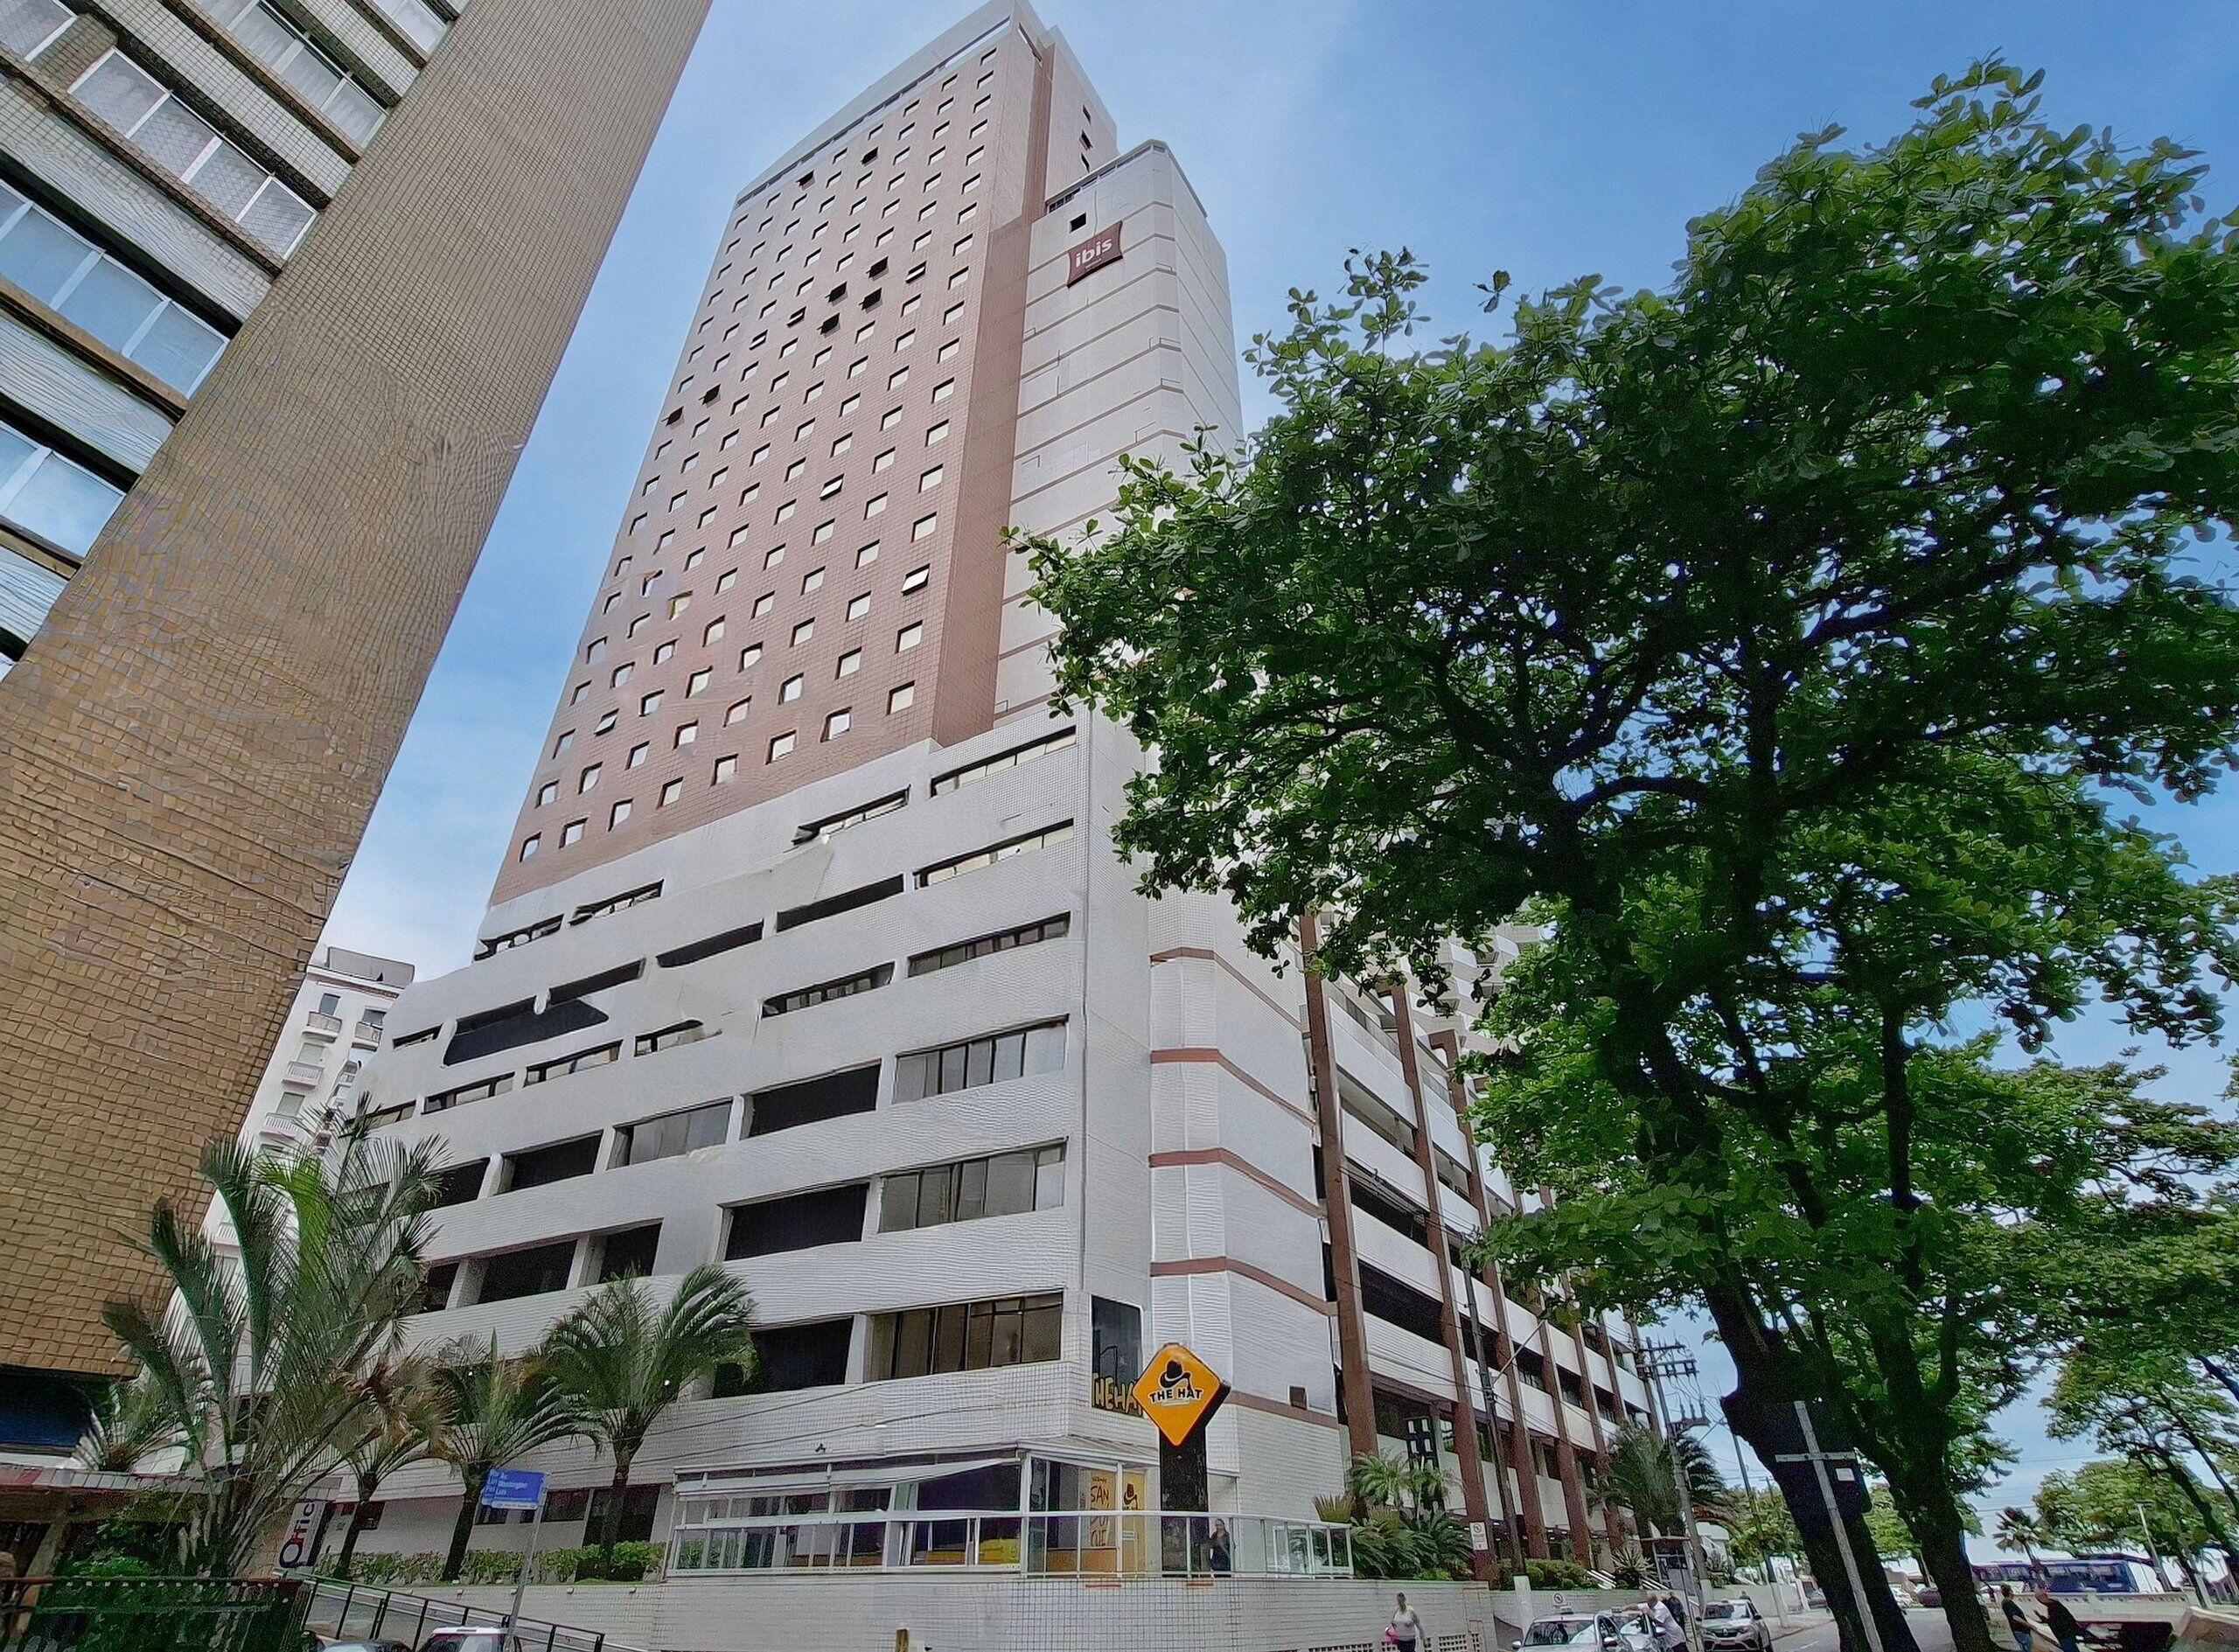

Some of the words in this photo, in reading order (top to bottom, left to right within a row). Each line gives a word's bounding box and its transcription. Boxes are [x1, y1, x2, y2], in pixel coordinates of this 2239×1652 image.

[1076, 238, 1113, 268] ibis
[1149, 1389, 1174, 1403] THE
[1177, 1387, 1203, 1399] HAT
[1090, 1485, 1109, 1505] SAN
